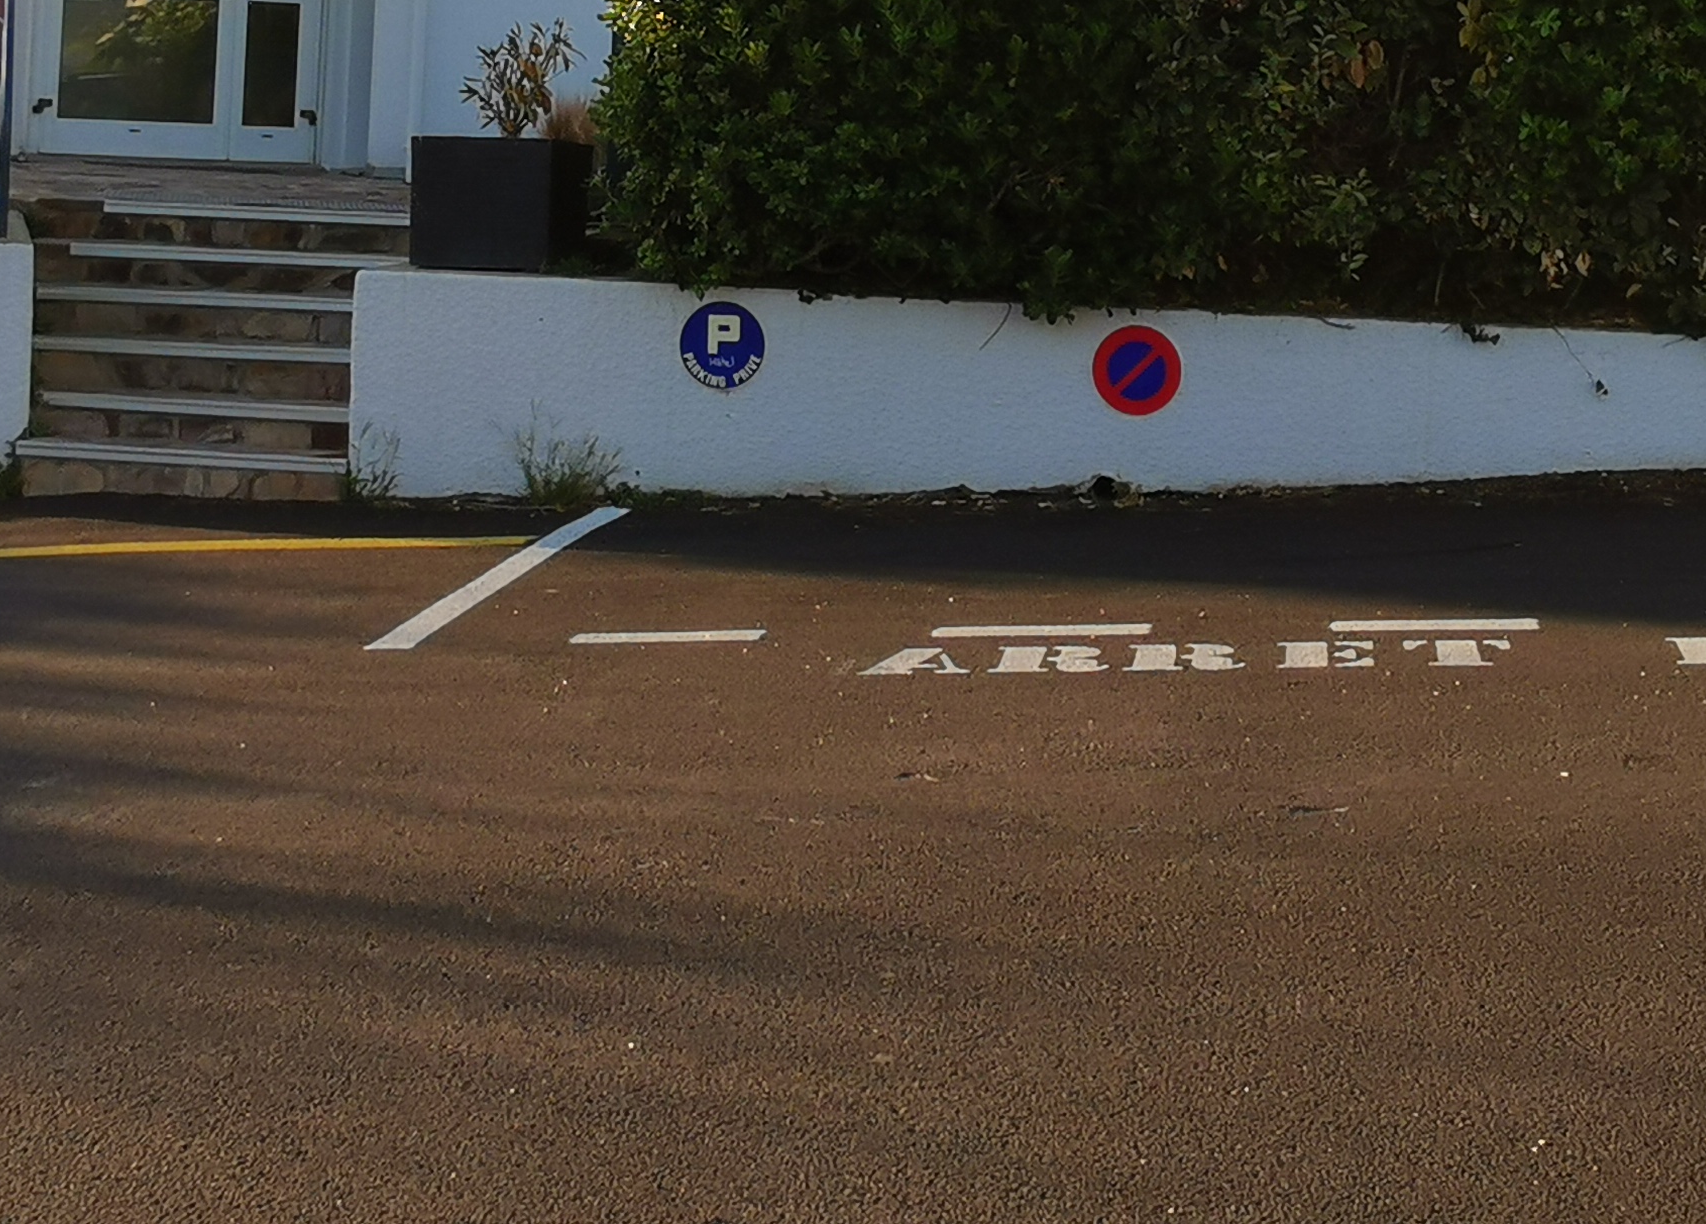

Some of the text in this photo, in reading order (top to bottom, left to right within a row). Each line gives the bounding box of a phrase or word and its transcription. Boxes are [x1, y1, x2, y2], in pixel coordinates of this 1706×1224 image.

[708, 314, 740, 354] P
[683, 352, 727, 387] PARKING
[858, 639, 1511, 675] ARRET
